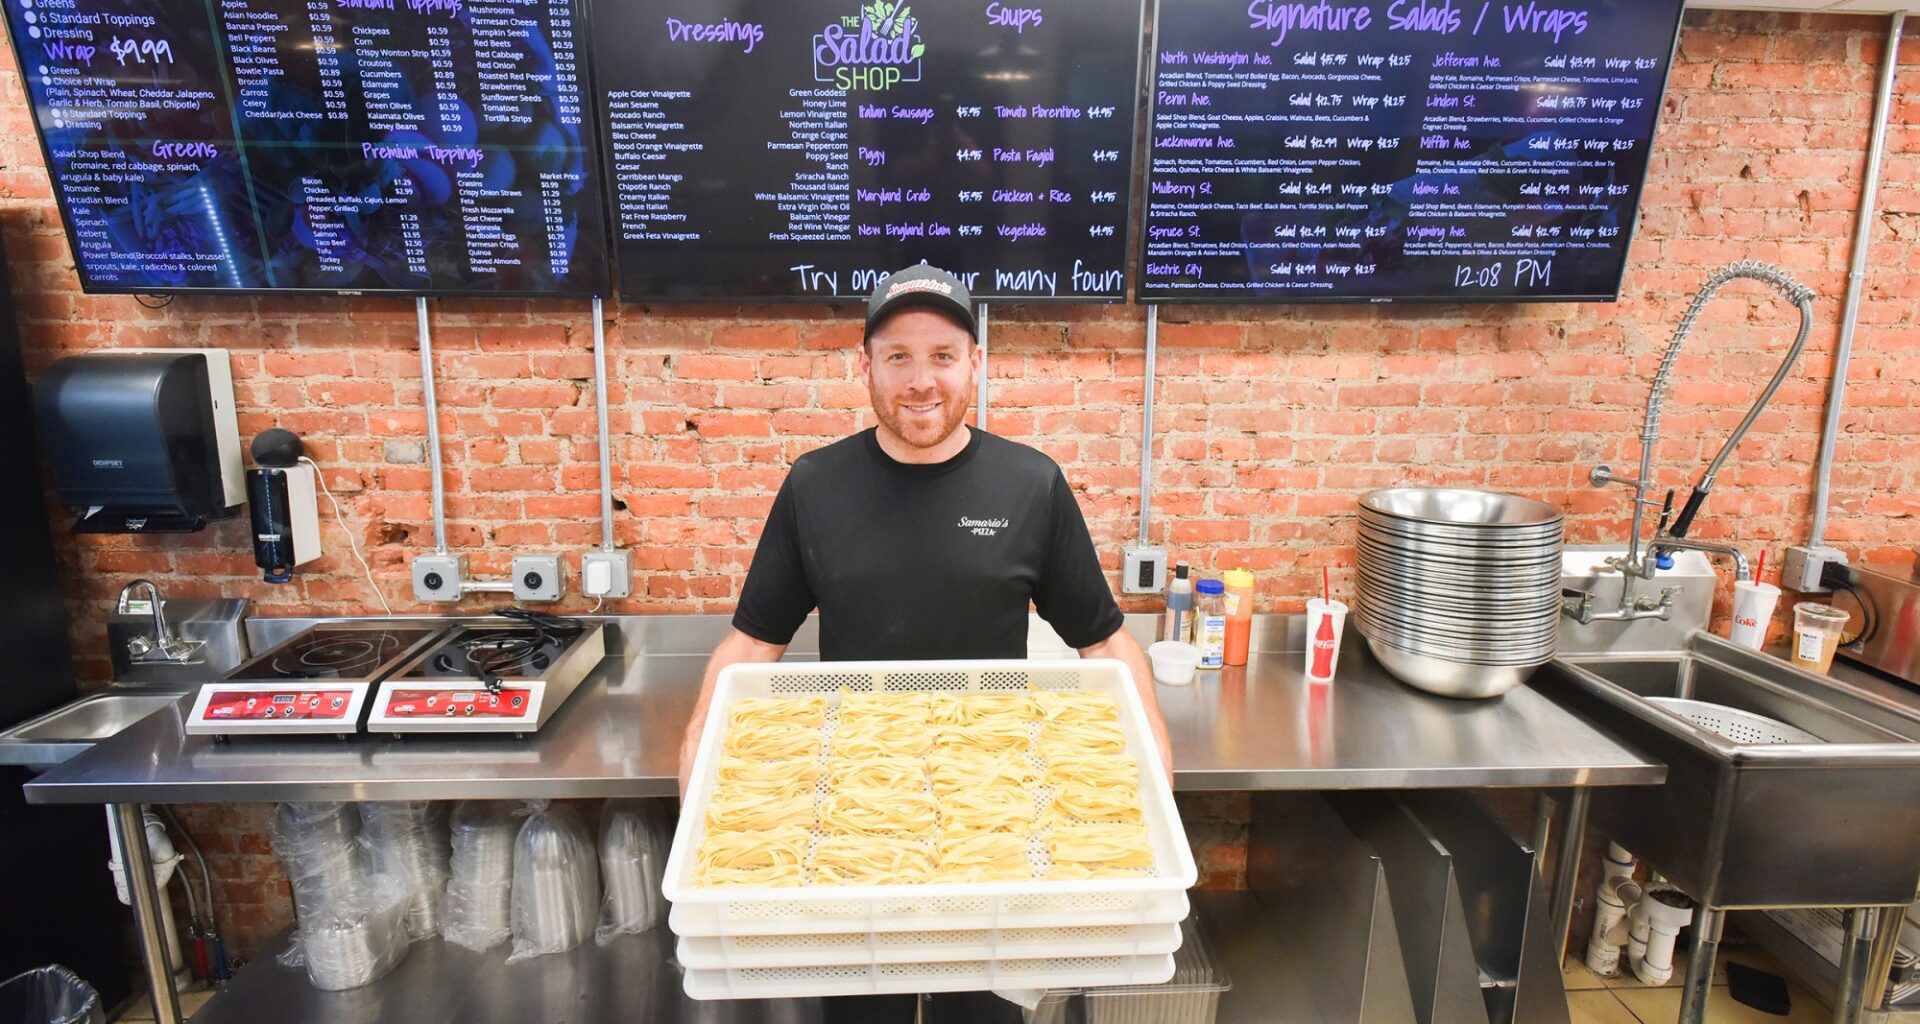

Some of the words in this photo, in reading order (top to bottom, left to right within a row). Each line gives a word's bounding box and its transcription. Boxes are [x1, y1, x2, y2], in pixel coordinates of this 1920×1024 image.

[36, 0, 75, 8] Greens
[221, 0, 248, 9] Apples
[469, 6, 515, 14] Mushrooms
[549, 8, 569, 16] $0.59
[39, 13, 47, 23] 6
[49, 12, 100, 25] Standard
[102, 13, 155, 27] Toppings
[309, 13, 330, 21] $0.59
[471, 17, 508, 25] Parmesan
[510, 18, 537, 27] Cheese
[550, 19, 570, 27] $0.89
[840, 16, 859, 29] THE
[986, 2, 1042, 33] Soups
[1248, 0, 1372, 47] Signature
[1387, 0, 1461, 35] Salads
[1504, 1, 1587, 43] Wraps
[43, 27, 93, 42] Dressing
[256, 23, 288, 32] Peppers
[352, 27, 390, 36] Chickpeas
[427, 27, 448, 35] $0.59
[666, 17, 764, 53] Dressings
[815, 16, 915, 67] Salad
[42, 39, 95, 67] Wrap
[110, 36, 173, 66] $9.99
[358, 59, 392, 67] Croutons
[477, 61, 491, 69] Red
[1161, 51, 1188, 64] North
[1193, 52, 1249, 70] Washington
[1254, 52, 1272, 64] Ave.
[1433, 52, 1479, 67] Jefferson
[1483, 55, 1501, 67] Ave.
[360, 70, 402, 78] Cucumbers
[554, 62, 575, 73] $0.59
[555, 63, 575, 71] Onion
[835, 67, 900, 91] SHOP
[814, 88, 847, 96] Goddess
[1159, 91, 1186, 105] Penn
[1192, 92, 1211, 105] Ave.
[803, 100, 827, 109] Honey
[1427, 93, 1458, 108] Linden
[1464, 95, 1475, 107] St.
[483, 104, 519, 112] Tomatoes
[560, 106, 580, 114] $0.59
[859, 104, 887, 118] Italian
[892, 106, 934, 124] Sausage
[957, 106, 981, 118] $5.95
[994, 106, 1027, 117] Tomato
[1032, 104, 1081, 118] Florentine
[1088, 106, 1115, 119] $4.95
[806, 142, 848, 151] Peppercorn
[1155, 135, 1212, 147] Lackawanna
[1217, 136, 1235, 147] Ave.
[1285, 135, 1307, 148] Salad
[1347, 137, 1373, 151] Wrap
[1420, 135, 1449, 148] Mifflin
[1454, 137, 1471, 149] Ave.
[53, 150, 76, 159] Salad
[77, 150, 99, 159] Shop
[101, 151, 125, 161] Blend
[153, 140, 217, 159] Greens
[362, 141, 419, 159] Premium
[425, 145, 483, 167] Toppings
[806, 152, 829, 161] Poppy
[830, 152, 848, 160] Seed
[859, 147, 885, 165] Piggy
[957, 149, 982, 161] $4.95
[994, 148, 1021, 161] Pasta
[1093, 150, 1118, 162] $4.95
[112, 160, 126, 169] red
[128, 161, 164, 173] cabbage,
[167, 163, 200, 172] spinach,
[61, 173, 92, 183] arugula
[103, 173, 123, 183] baby
[125, 174, 144, 183] kale)
[457, 170, 483, 178] Avocado
[63, 184, 100, 192] Romaine
[459, 189, 479, 199] Crispy
[480, 189, 500, 197] Onion
[1152, 181, 1195, 198] Mulberry
[1200, 182, 1212, 194] St.
[1412, 181, 1439, 195] Adams
[1443, 183, 1459, 194] Ave.
[857, 188, 901, 206] Maryland
[906, 188, 930, 201] Crab
[959, 190, 983, 202] $5.95
[992, 190, 1033, 202] Chicken
[1050, 190, 1071, 202] Rice
[1091, 191, 1116, 203] $4.95
[75, 218, 109, 228] Spinach
[858, 224, 880, 235] New
[886, 223, 923, 241] England
[929, 223, 951, 235] Clam
[958, 225, 982, 236] $5.95
[997, 223, 1046, 241] Vegetable
[1090, 225, 1114, 237] $4.95
[1149, 226, 1183, 240] Spruce
[1188, 225, 1200, 237] St.
[1407, 226, 1445, 243] Wyoming
[1449, 227, 1467, 238] Ave.
[81, 241, 112, 250] Arugula
[1147, 263, 1180, 275] Electric
[1185, 264, 1202, 279] City
[1455, 262, 1501, 287] 12:08
[1515, 259, 1551, 286] PM
[790, 265, 837, 296] Try
[852, 269, 891, 292] one
[995, 269, 1057, 297] many
[958, 516, 1009, 528] Samario's
